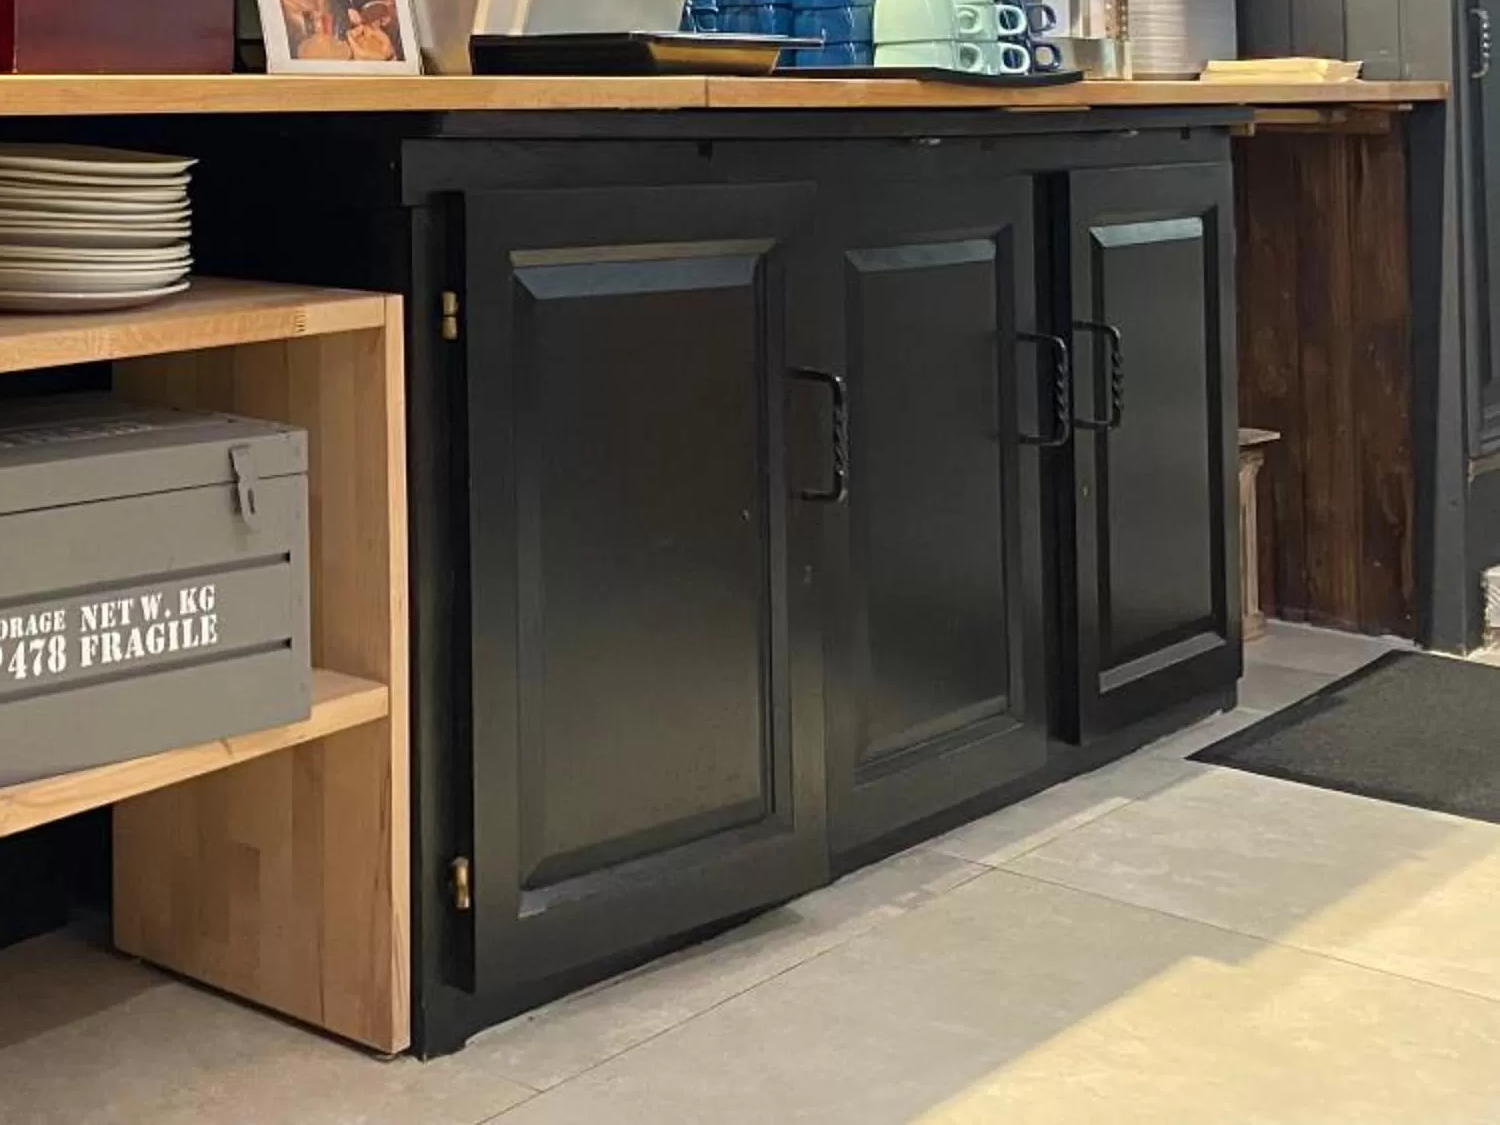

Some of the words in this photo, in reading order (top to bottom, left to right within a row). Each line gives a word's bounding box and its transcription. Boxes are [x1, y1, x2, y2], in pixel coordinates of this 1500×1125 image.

[80, 599, 134, 633] NET
[140, 592, 172, 622] W.
[179, 584, 216, 616] KG
[7, 634, 67, 680] 478
[80, 614, 218, 668] FRAGILE
